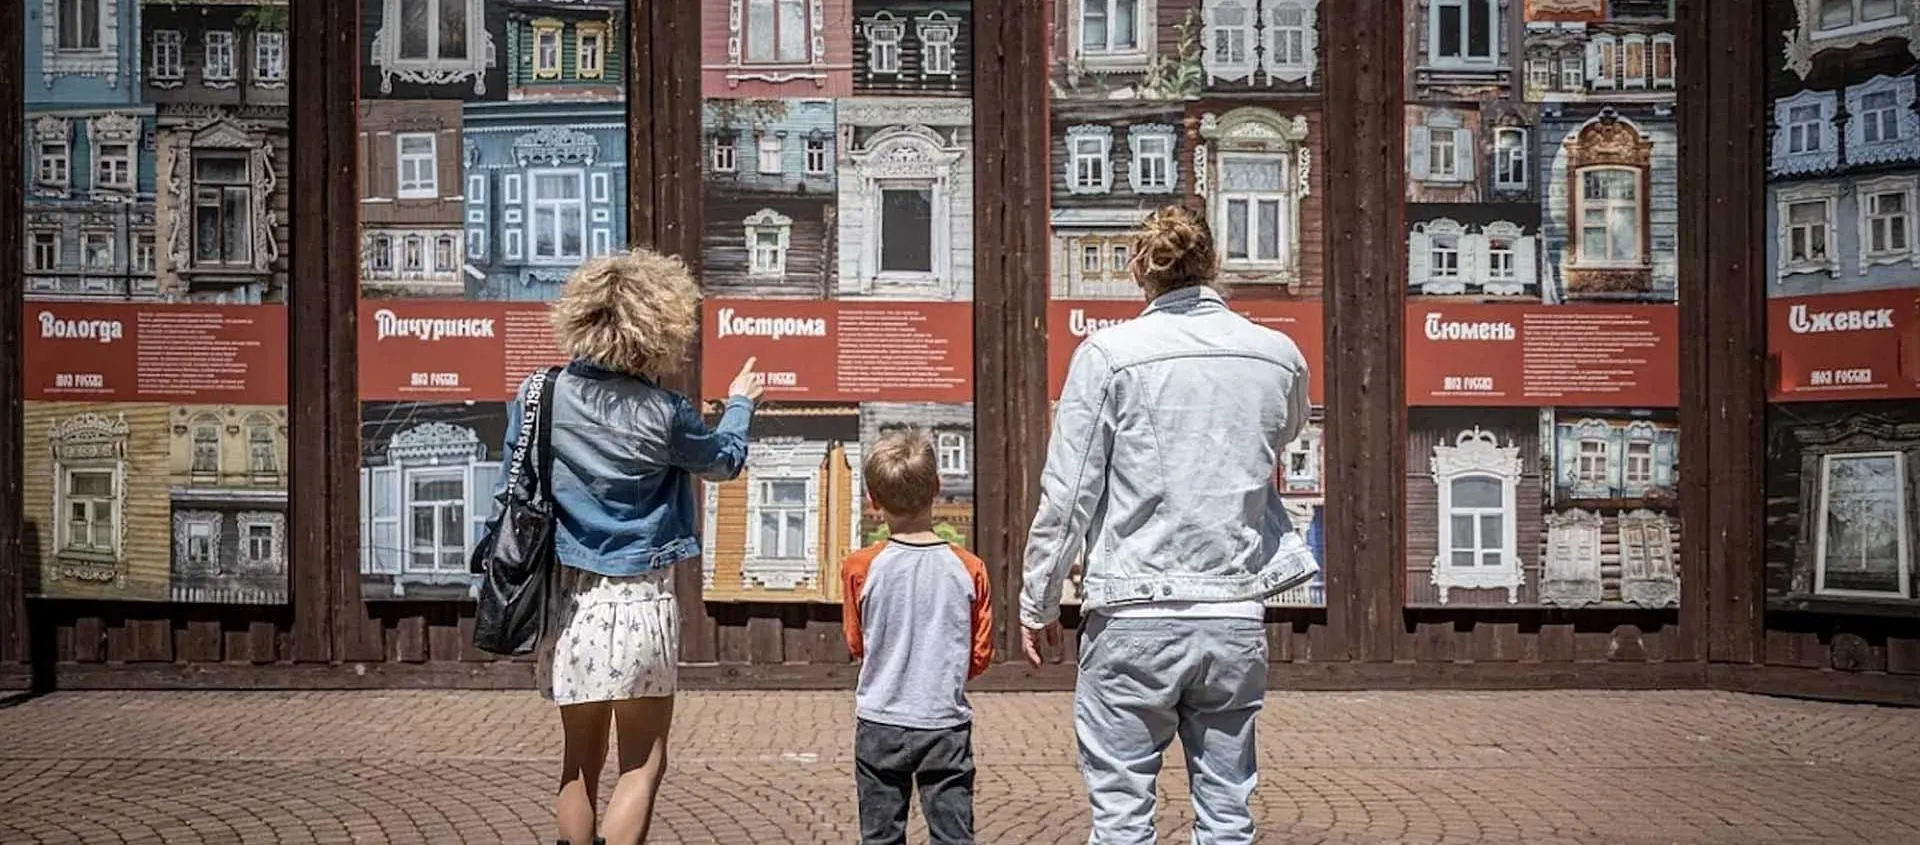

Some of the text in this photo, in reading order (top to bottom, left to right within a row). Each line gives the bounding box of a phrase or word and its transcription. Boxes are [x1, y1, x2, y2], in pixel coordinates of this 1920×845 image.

[38, 311, 122, 342] Вологда
[374, 308, 495, 341] Мичуринск
[717, 307, 826, 339] Кострома
[1424, 312, 1516, 341] Тюмень
[1788, 304, 1895, 334] Ижевск
